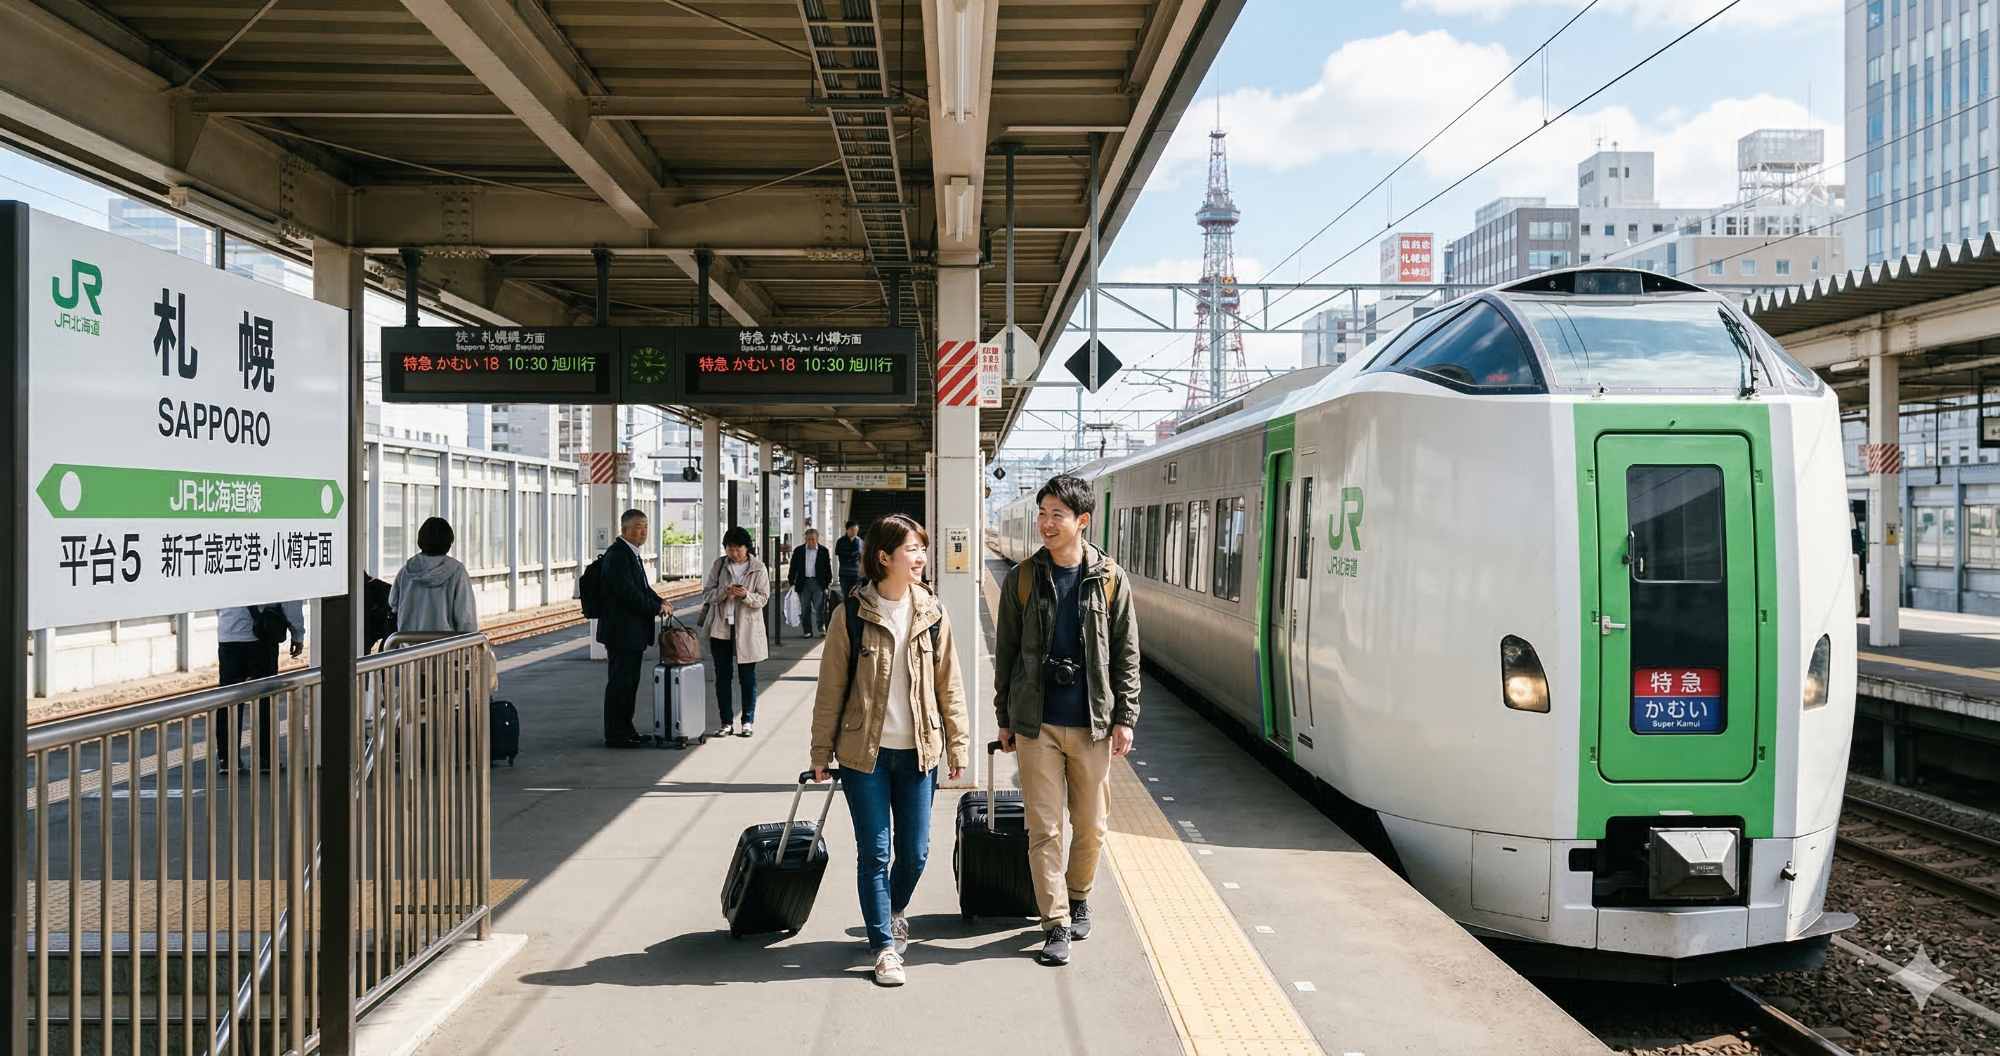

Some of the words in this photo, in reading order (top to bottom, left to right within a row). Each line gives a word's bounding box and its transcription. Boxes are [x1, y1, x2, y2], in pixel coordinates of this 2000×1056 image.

[52, 259, 102, 315] JR
[55, 312, 100, 336] JR北海道
[739, 331, 765, 345] 特急
[403, 356, 433, 372] 特急
[436, 356, 479, 371] かむい
[484, 356, 500, 371] 18
[507, 356, 548, 371] 10:30
[552, 356, 596, 372] 旭川行
[699, 357, 729, 373] 特急
[733, 357, 775, 372] かむい
[779, 357, 796, 372] 18
[804, 357, 845, 372] 10:30
[849, 357, 894, 373] 旭川行
[158, 397, 271, 447] SAPPORO
[170, 479, 262, 513] JR北海道線
[1328, 487, 1364, 551] JR
[59, 533, 141, 587] 平台5
[1650, 671, 1702, 693] 特急
[1645, 700, 1708, 719] かむい
[1652, 720, 1674, 729] Super
[1676, 720, 1701, 728] Kamui
